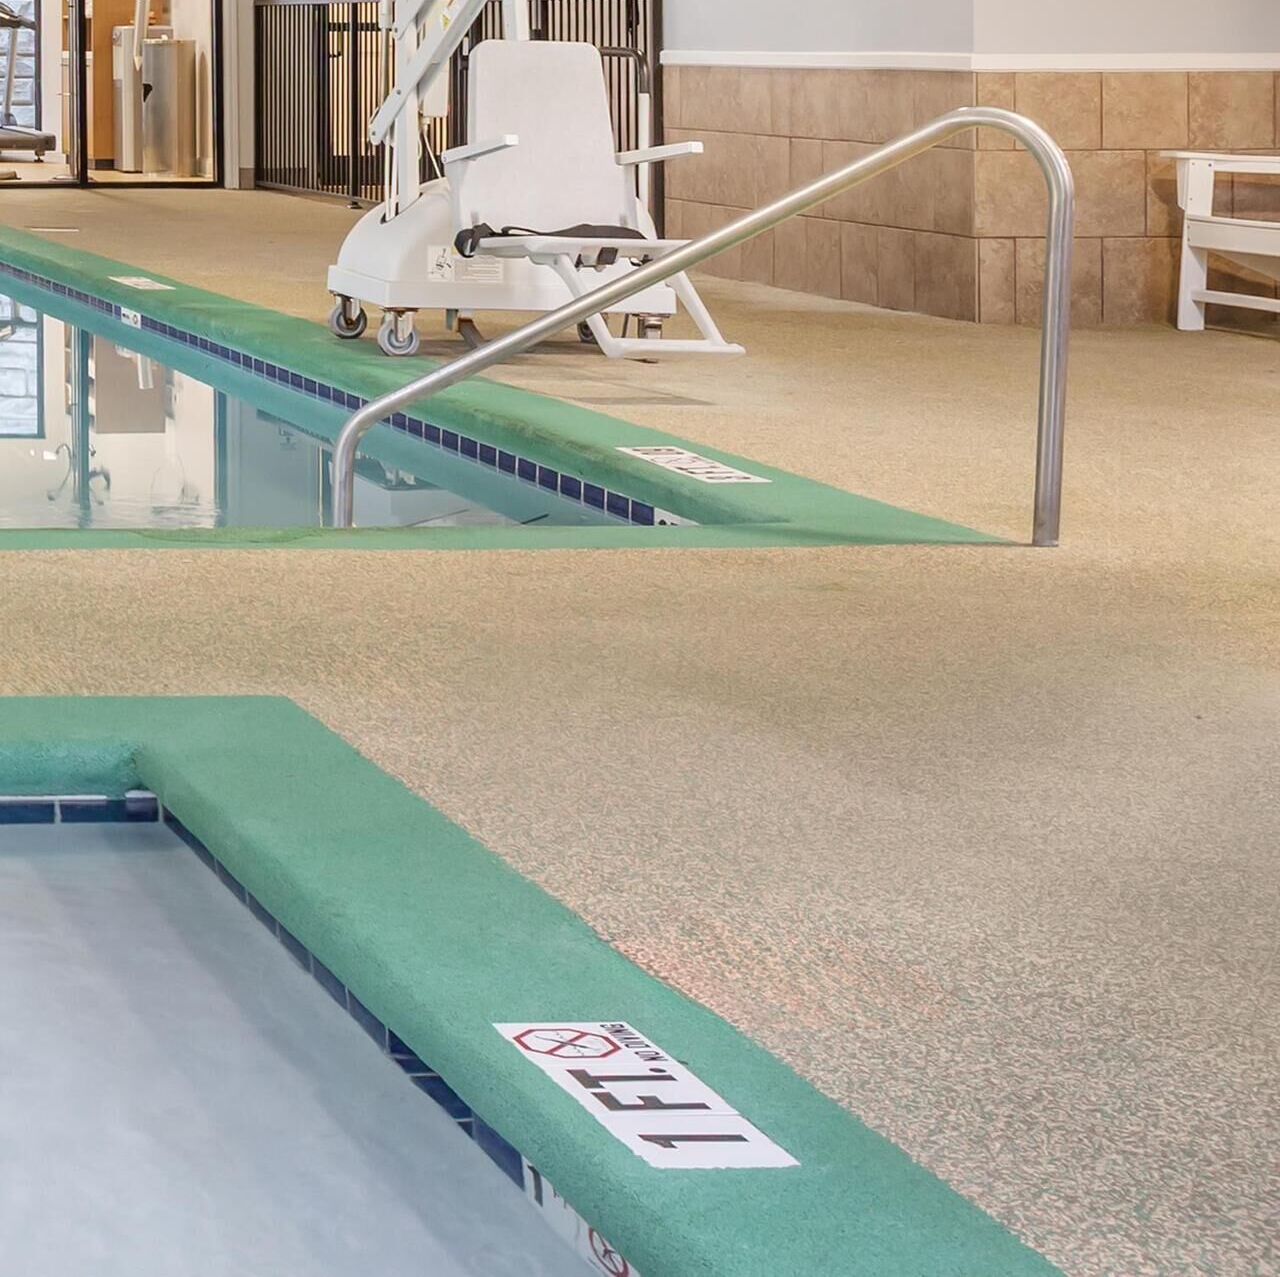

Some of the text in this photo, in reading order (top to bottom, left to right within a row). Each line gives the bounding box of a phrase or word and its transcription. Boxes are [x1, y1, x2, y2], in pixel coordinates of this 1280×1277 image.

[599, 1023, 667, 1062] NO DIVING
[566, 1067, 749, 1149] 1 FT.
